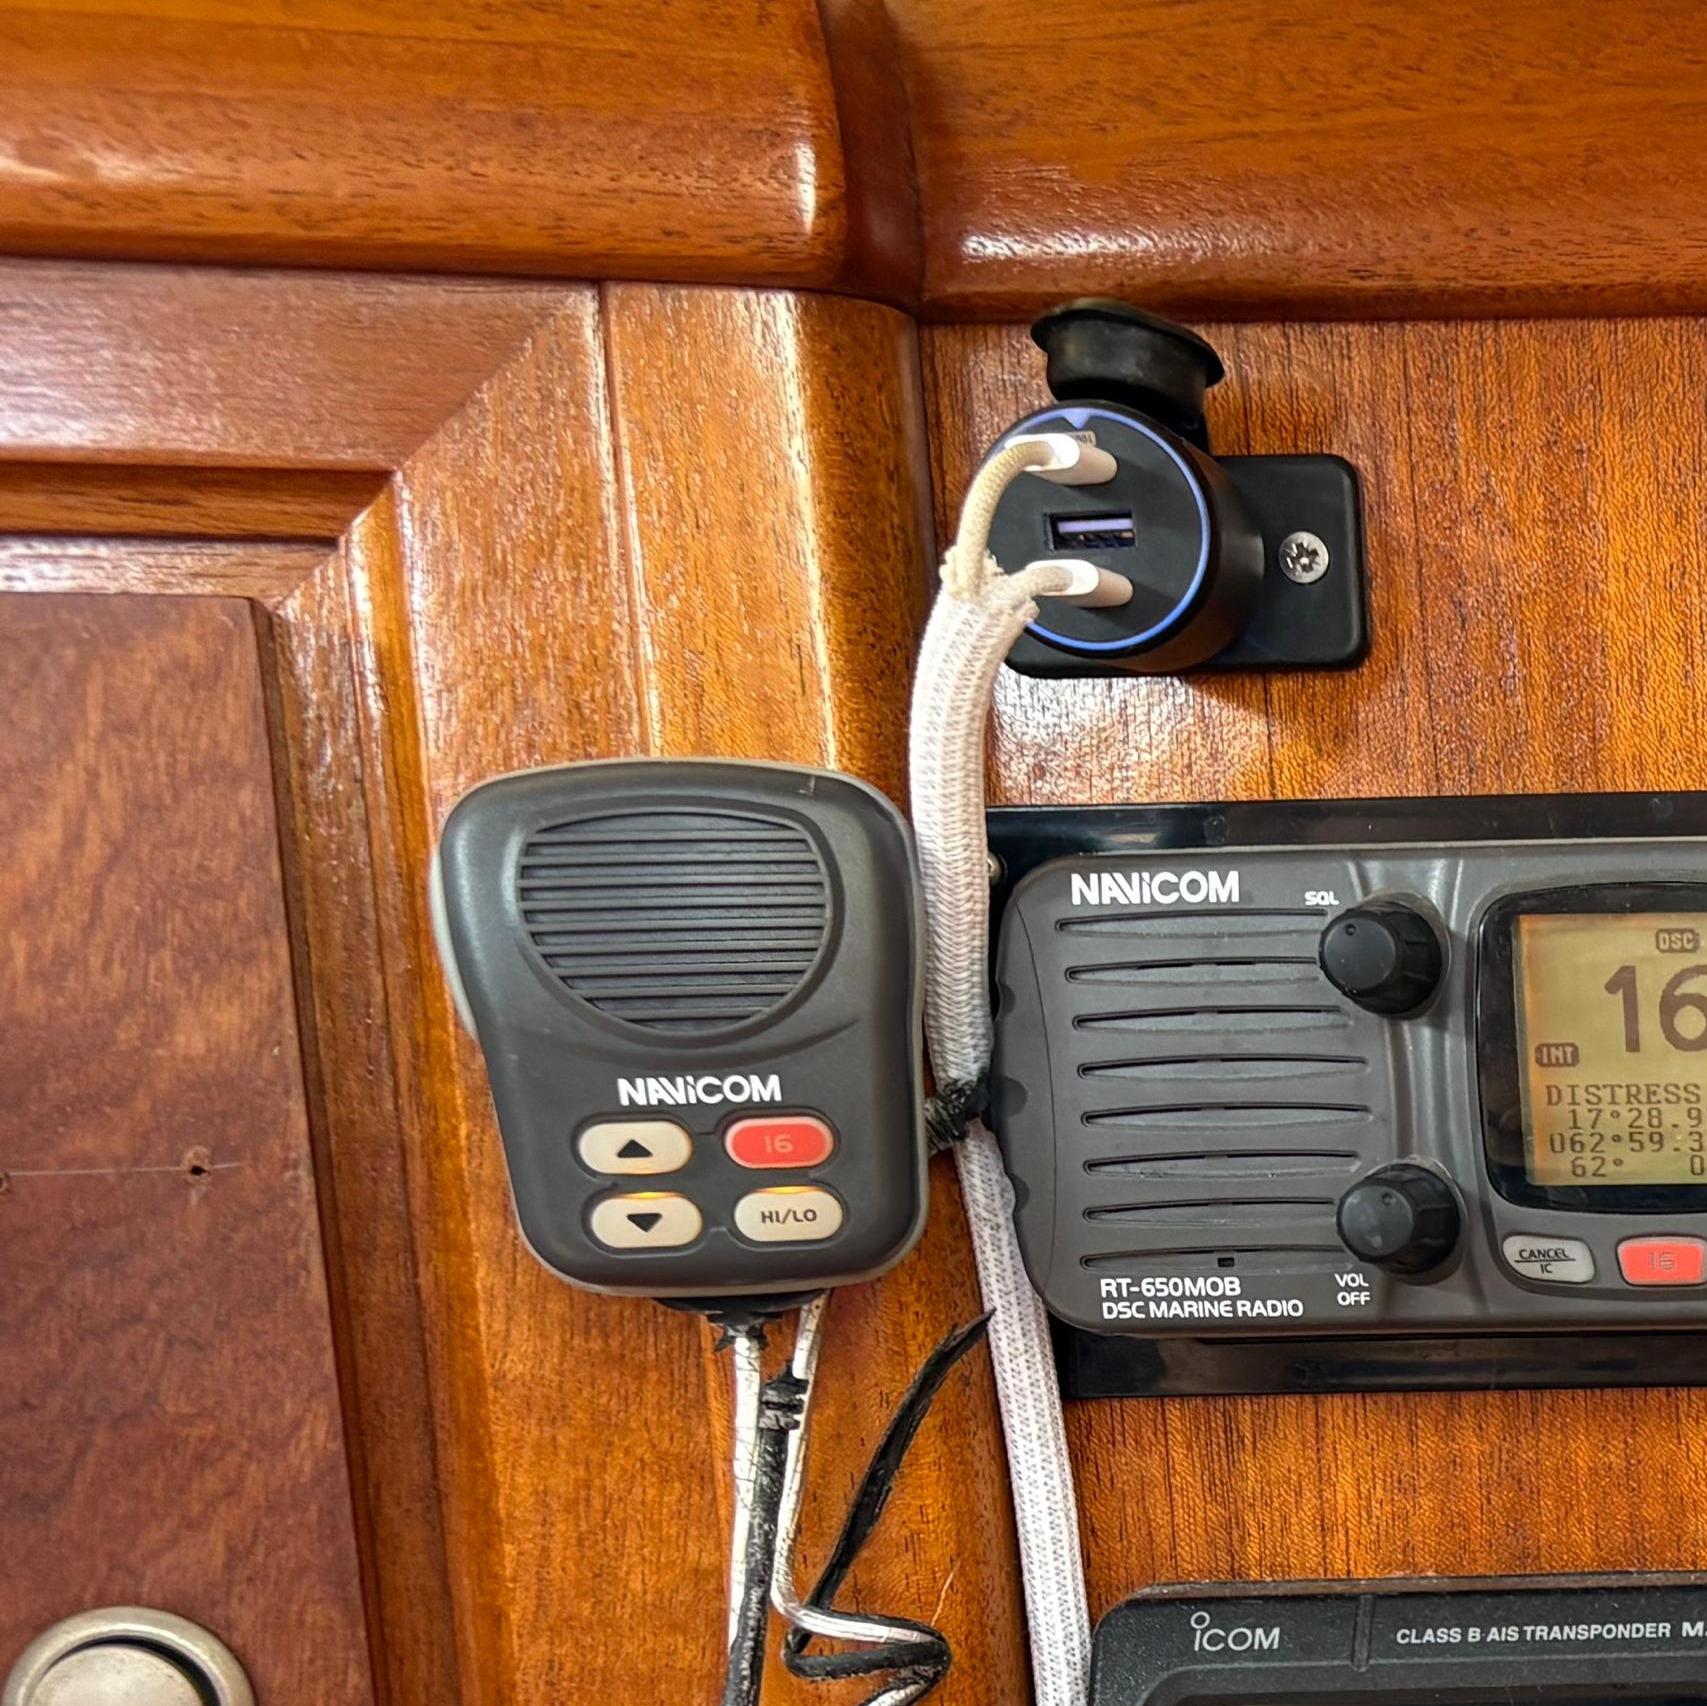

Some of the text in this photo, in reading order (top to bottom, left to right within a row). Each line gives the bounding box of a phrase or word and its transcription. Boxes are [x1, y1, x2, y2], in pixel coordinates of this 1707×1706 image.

[1304, 892, 1339, 906] SQL
[1540, 1045, 1575, 1064] INT
[1545, 1083, 1701, 1105] DISTRESS
[1571, 1156, 1624, 1178] 62°
[760, 1209, 817, 1224] HI/LO
[1519, 1248, 1570, 1260] CANCEL
[1100, 1278, 1242, 1298] RT-650MOB
[1337, 1292, 1370, 1306] OFF
[1102, 1299, 1304, 1319] DSC MARINE RADIO
[1396, 1627, 1461, 1645] CLASS
[1523, 1622, 1671, 1641] TRANSPONDER
